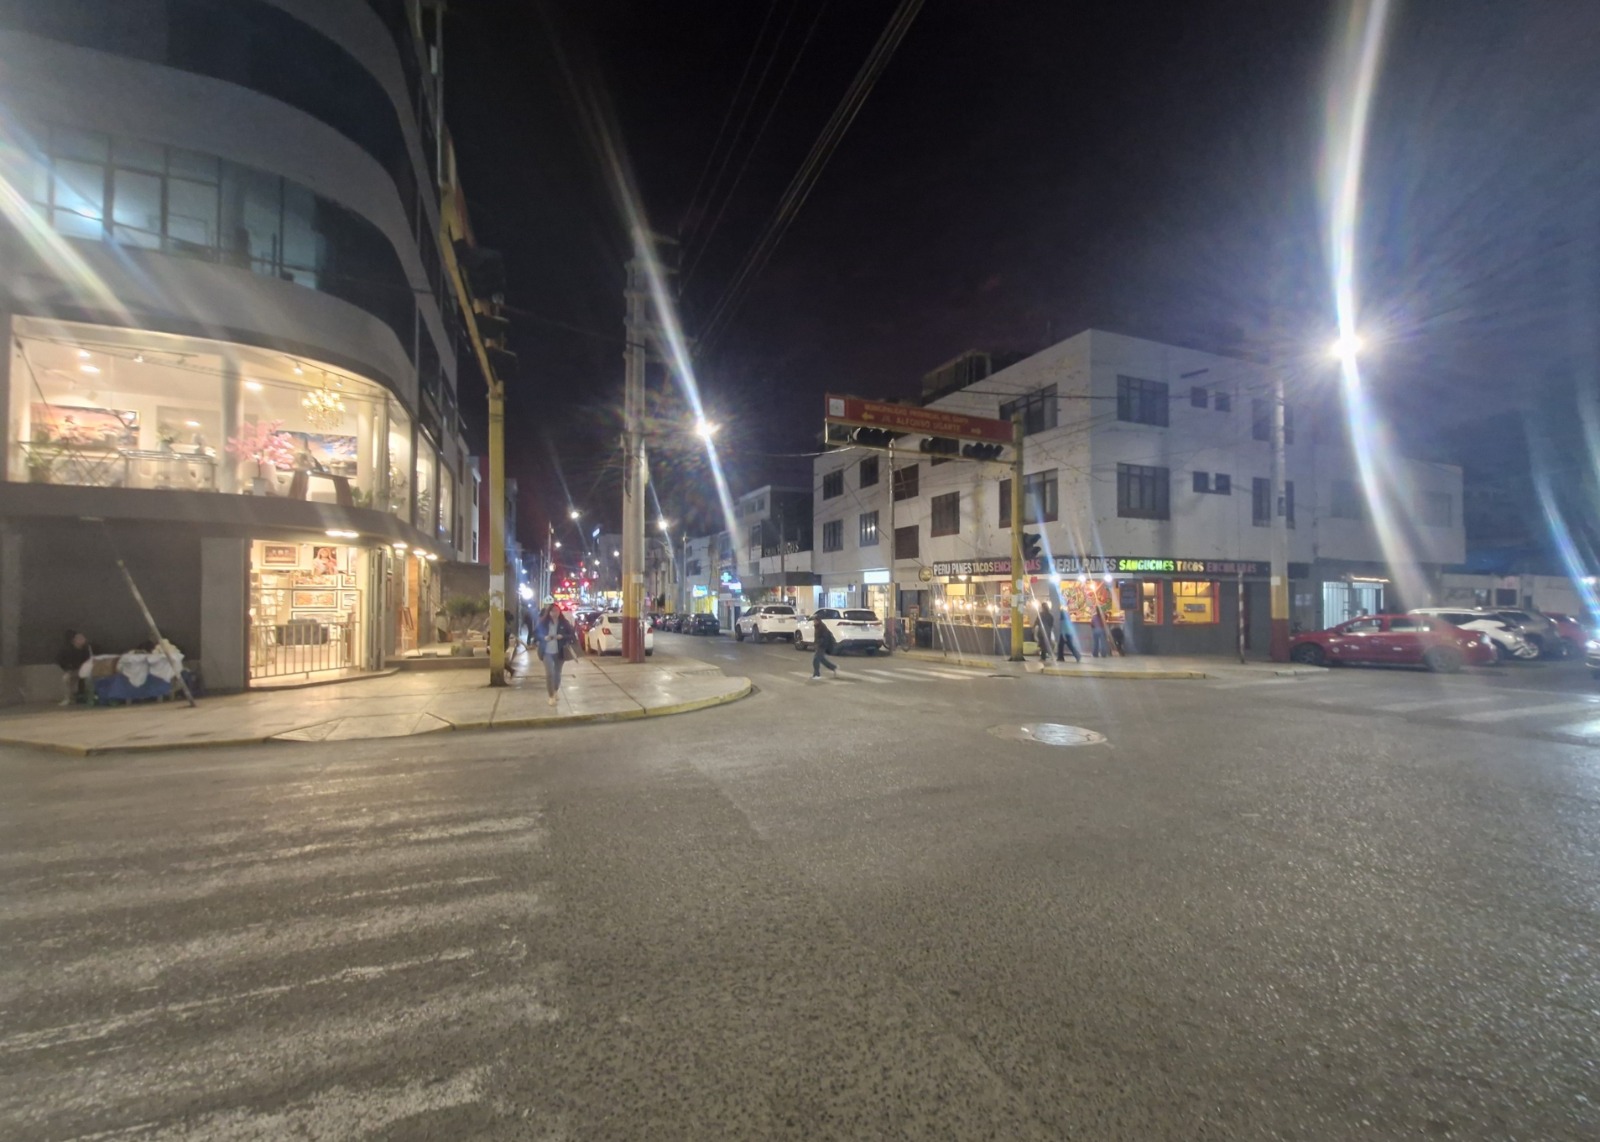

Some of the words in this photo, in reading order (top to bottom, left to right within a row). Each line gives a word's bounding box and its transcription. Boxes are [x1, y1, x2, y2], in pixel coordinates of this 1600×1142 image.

[896, 416, 931, 428] ALFONSO
[932, 421, 961, 433] UGARTE
[933, 563, 951, 576] PERU
[951, 562, 972, 575] PANES
[972, 561, 994, 573] TACOS
[1082, 558, 1118, 572] PANES
[1119, 559, 1174, 571] SANGUCHES
[1175, 560, 1204, 572] TACOS
